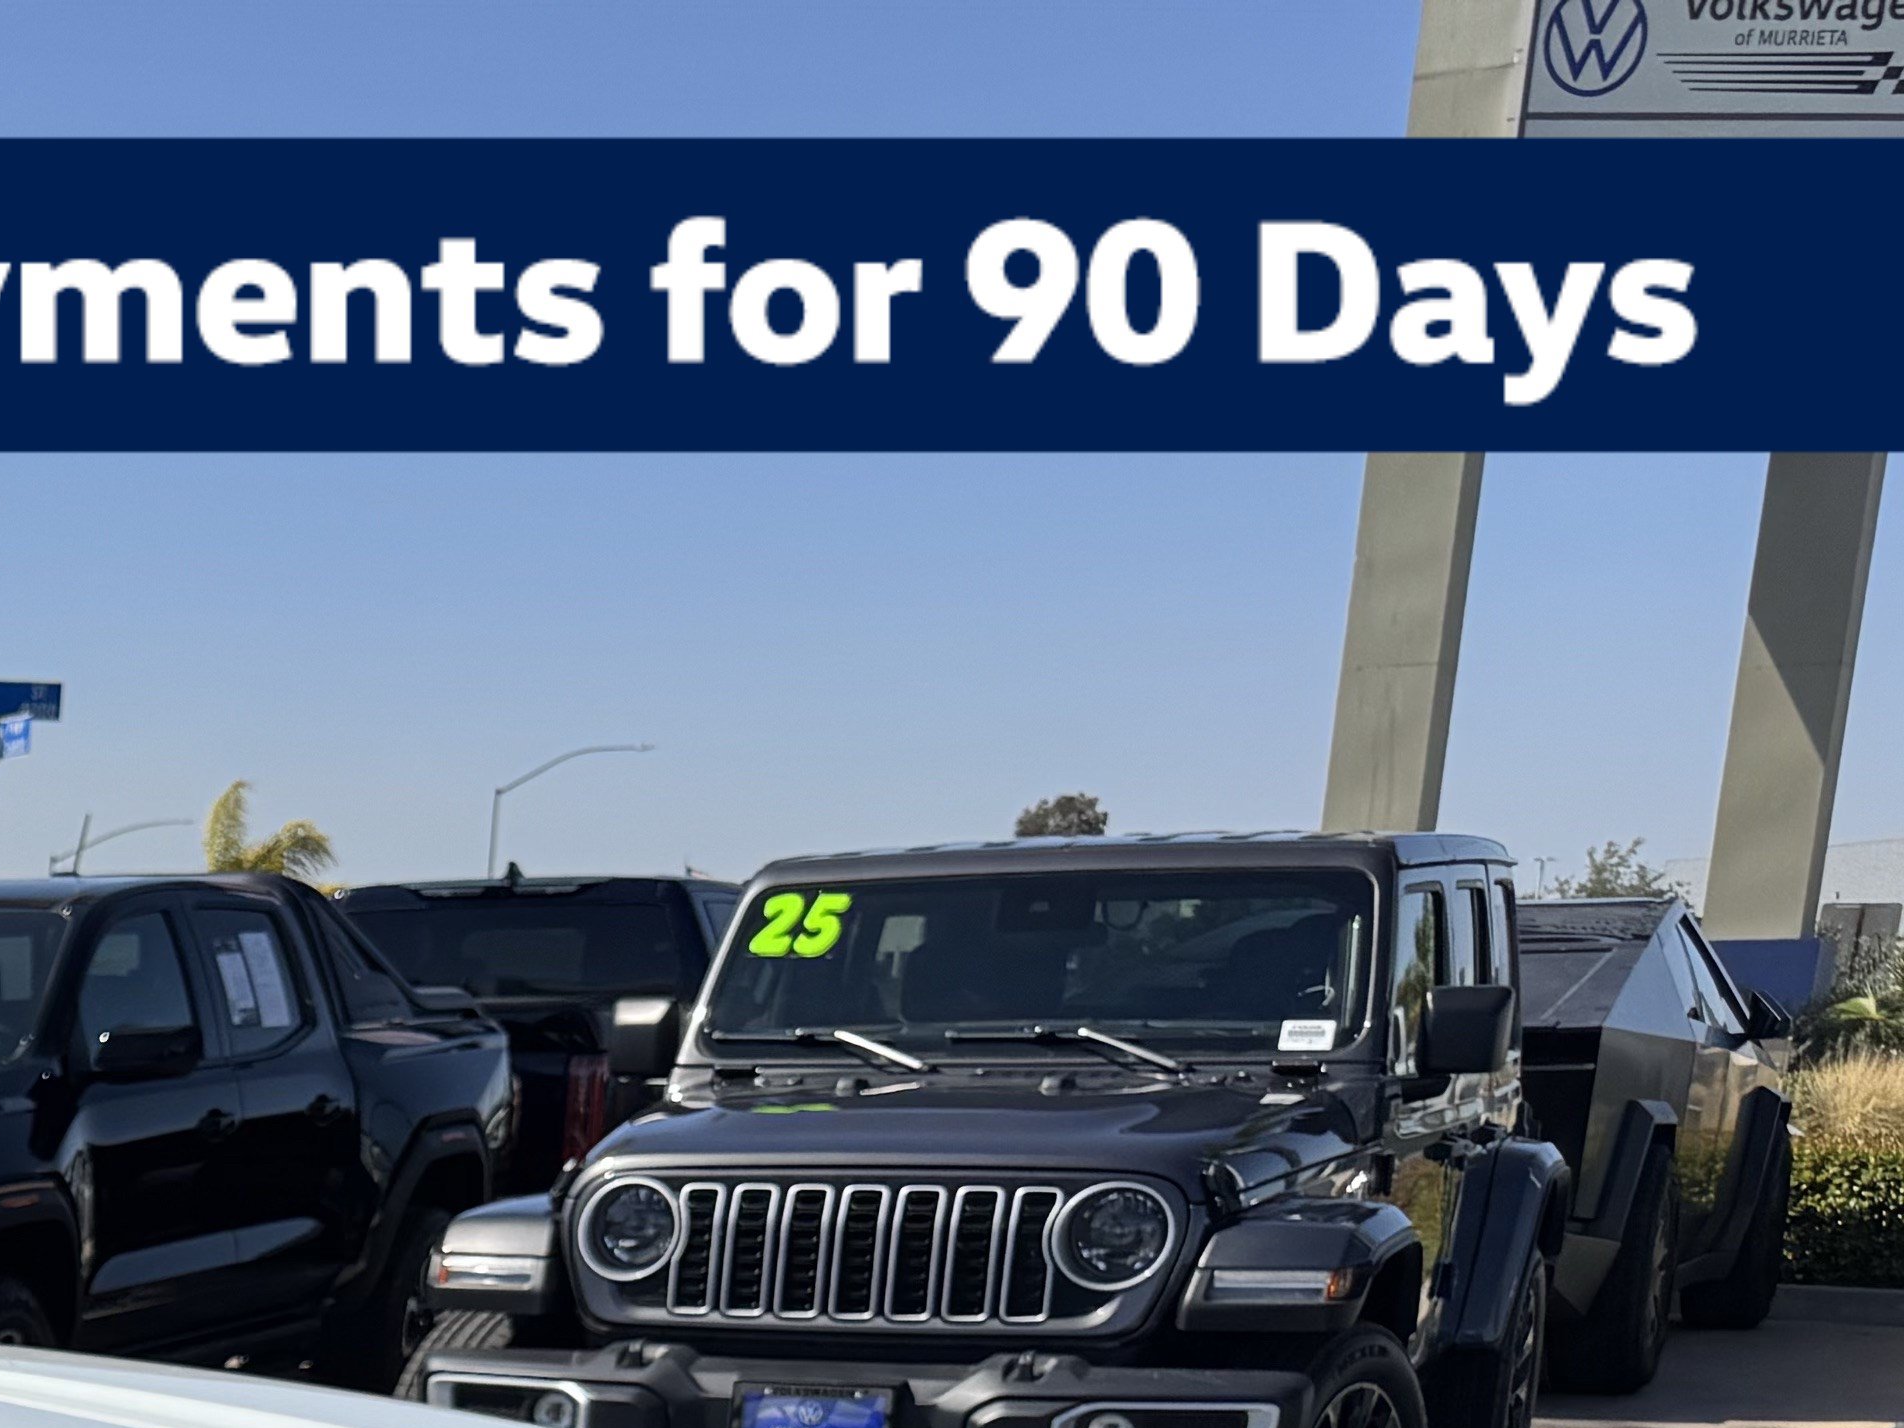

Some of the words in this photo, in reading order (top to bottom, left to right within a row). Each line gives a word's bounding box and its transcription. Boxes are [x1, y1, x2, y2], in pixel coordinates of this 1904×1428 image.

[1734, 29, 1755, 46] of
[1758, 30, 1848, 46] MURRIETA
[749, 892, 853, 956] 25
